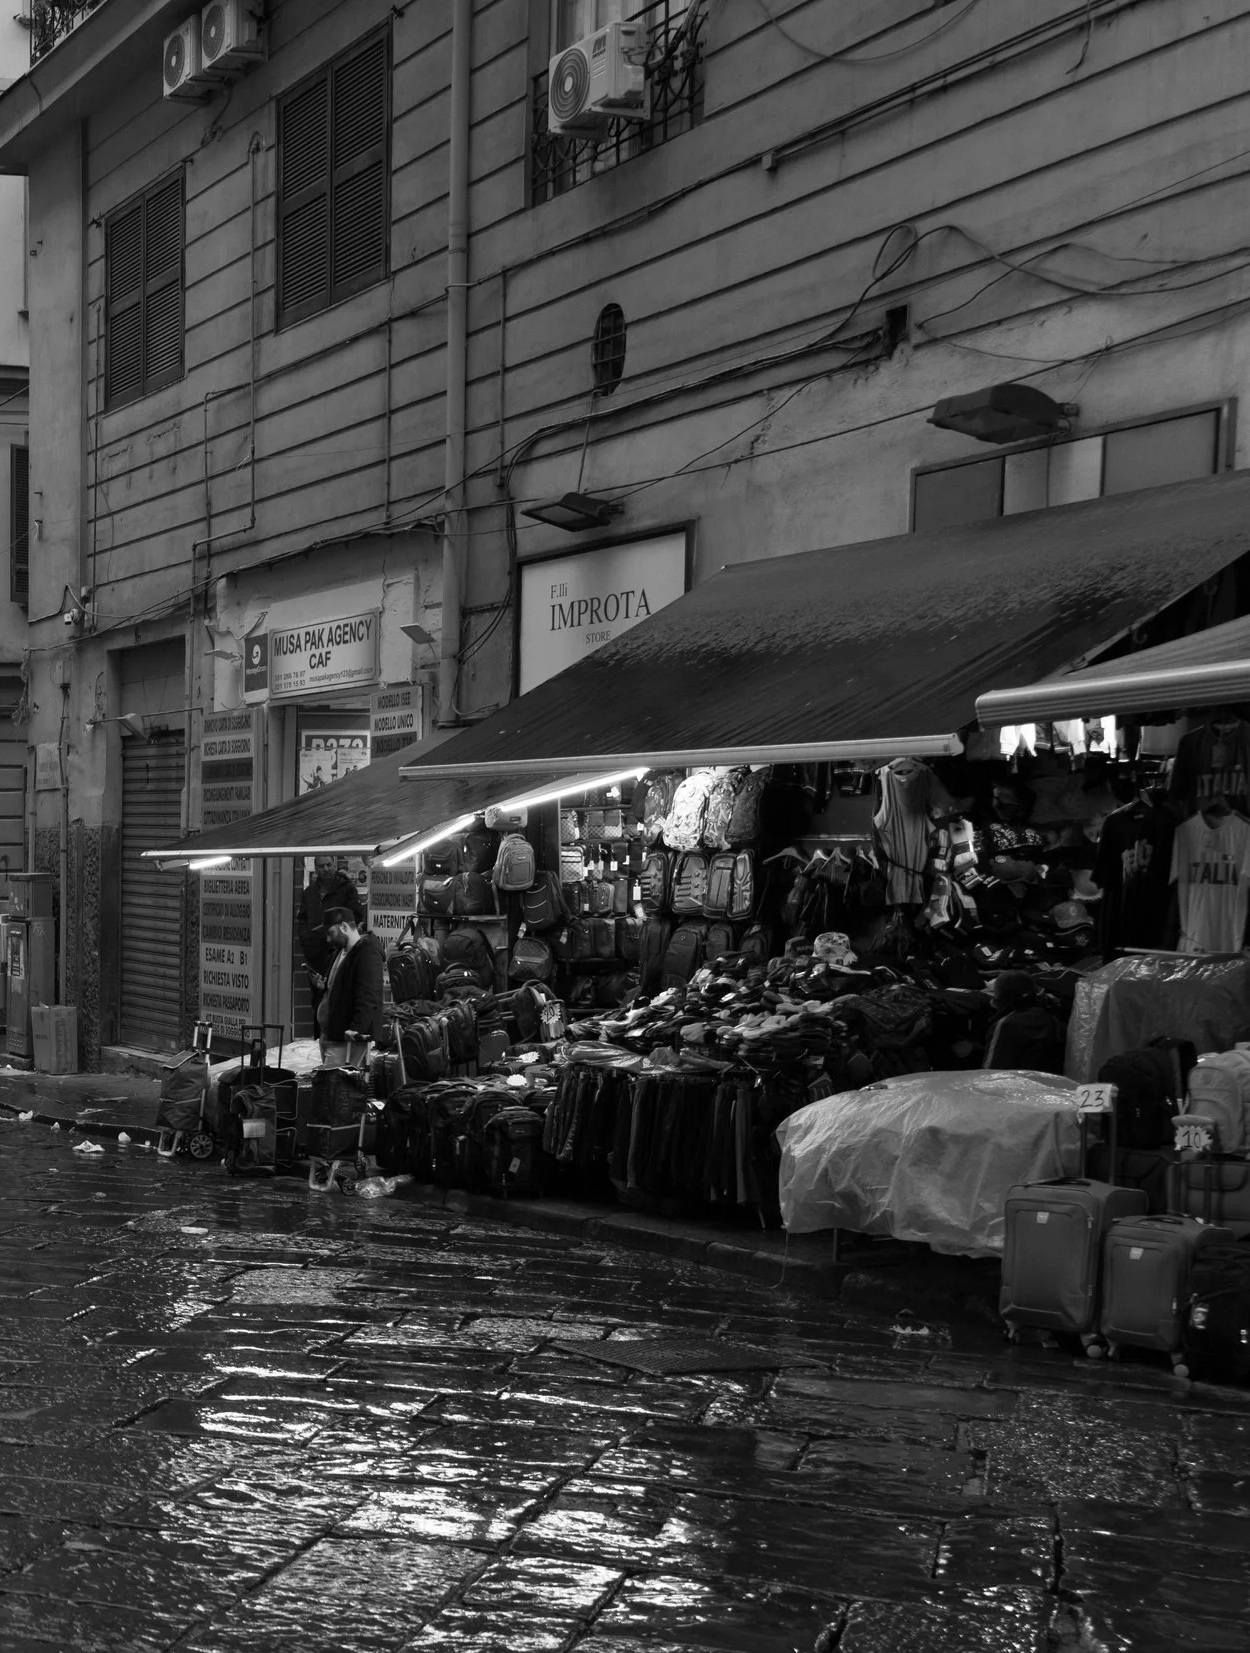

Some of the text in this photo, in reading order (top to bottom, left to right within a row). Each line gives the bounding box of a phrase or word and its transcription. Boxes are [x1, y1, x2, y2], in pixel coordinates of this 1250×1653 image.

[550, 582, 568, 600] F.lli
[549, 587, 652, 632] IMPROTA
[273, 618, 373, 657] MUSA PAK AGENCY
[585, 630, 612, 645] STORE
[308, 651, 332, 670] CAF
[377, 691, 411, 710] MODELLO ISEE
[374, 713, 414, 732] MODELLO UNICO
[205, 947, 248, 966] ESAME A2 B1
[204, 969, 250, 990] RICHIESTA VISTO
[543, 1006, 556, 1021] 20
[1079, 1089, 1105, 1110] 23
[1181, 1130, 1202, 1149] 10
